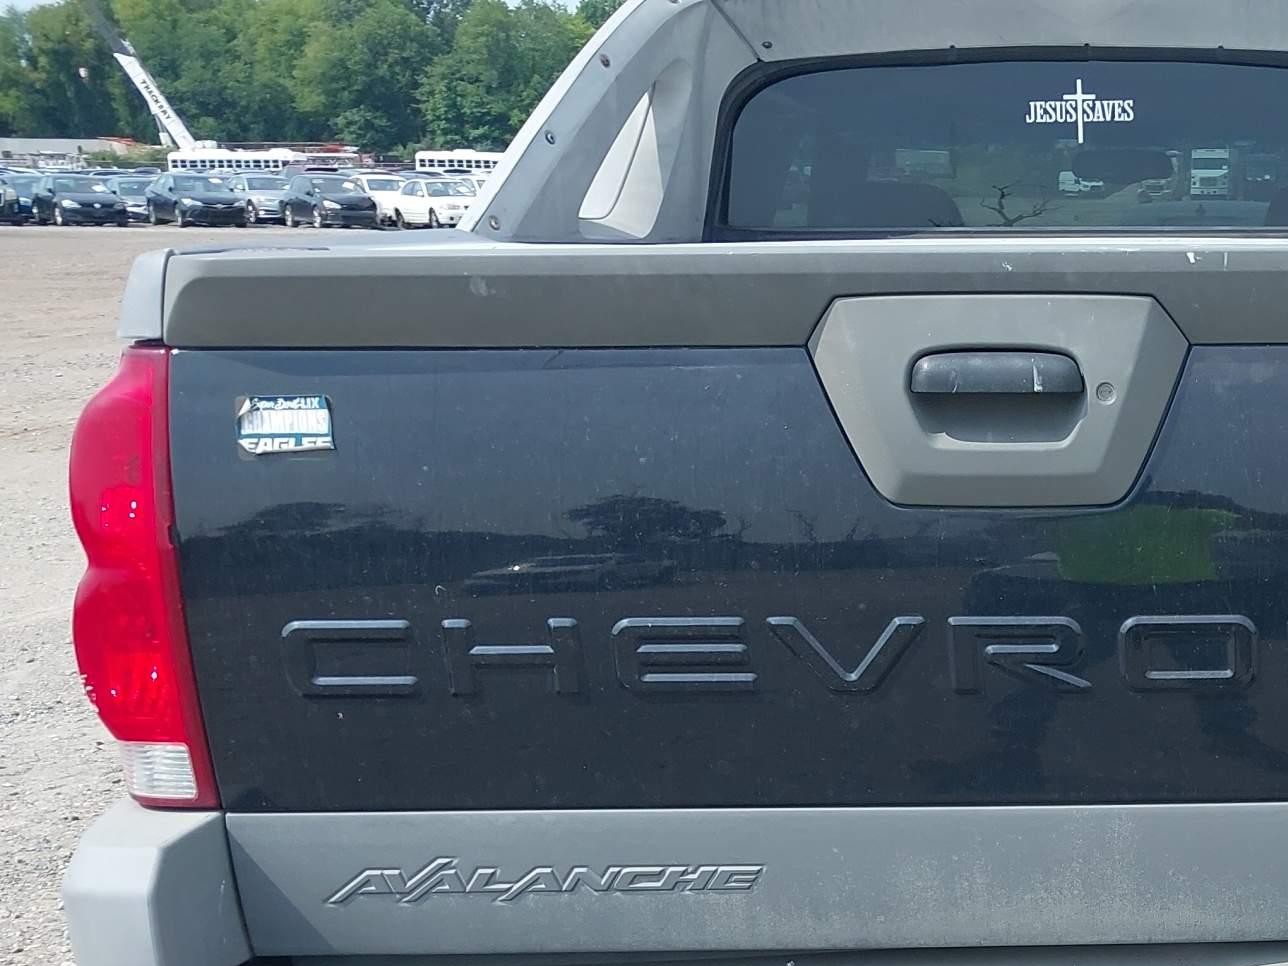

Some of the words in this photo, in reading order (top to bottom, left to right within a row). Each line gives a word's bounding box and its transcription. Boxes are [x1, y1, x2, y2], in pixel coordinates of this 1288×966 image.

[1025, 100, 1077, 123] JESUS
[1083, 99, 1135, 122] SAVES
[301, 396, 320, 409] LIX
[242, 410, 328, 433] CHAMPIONS
[326, 856, 768, 905] AVALANCHE
